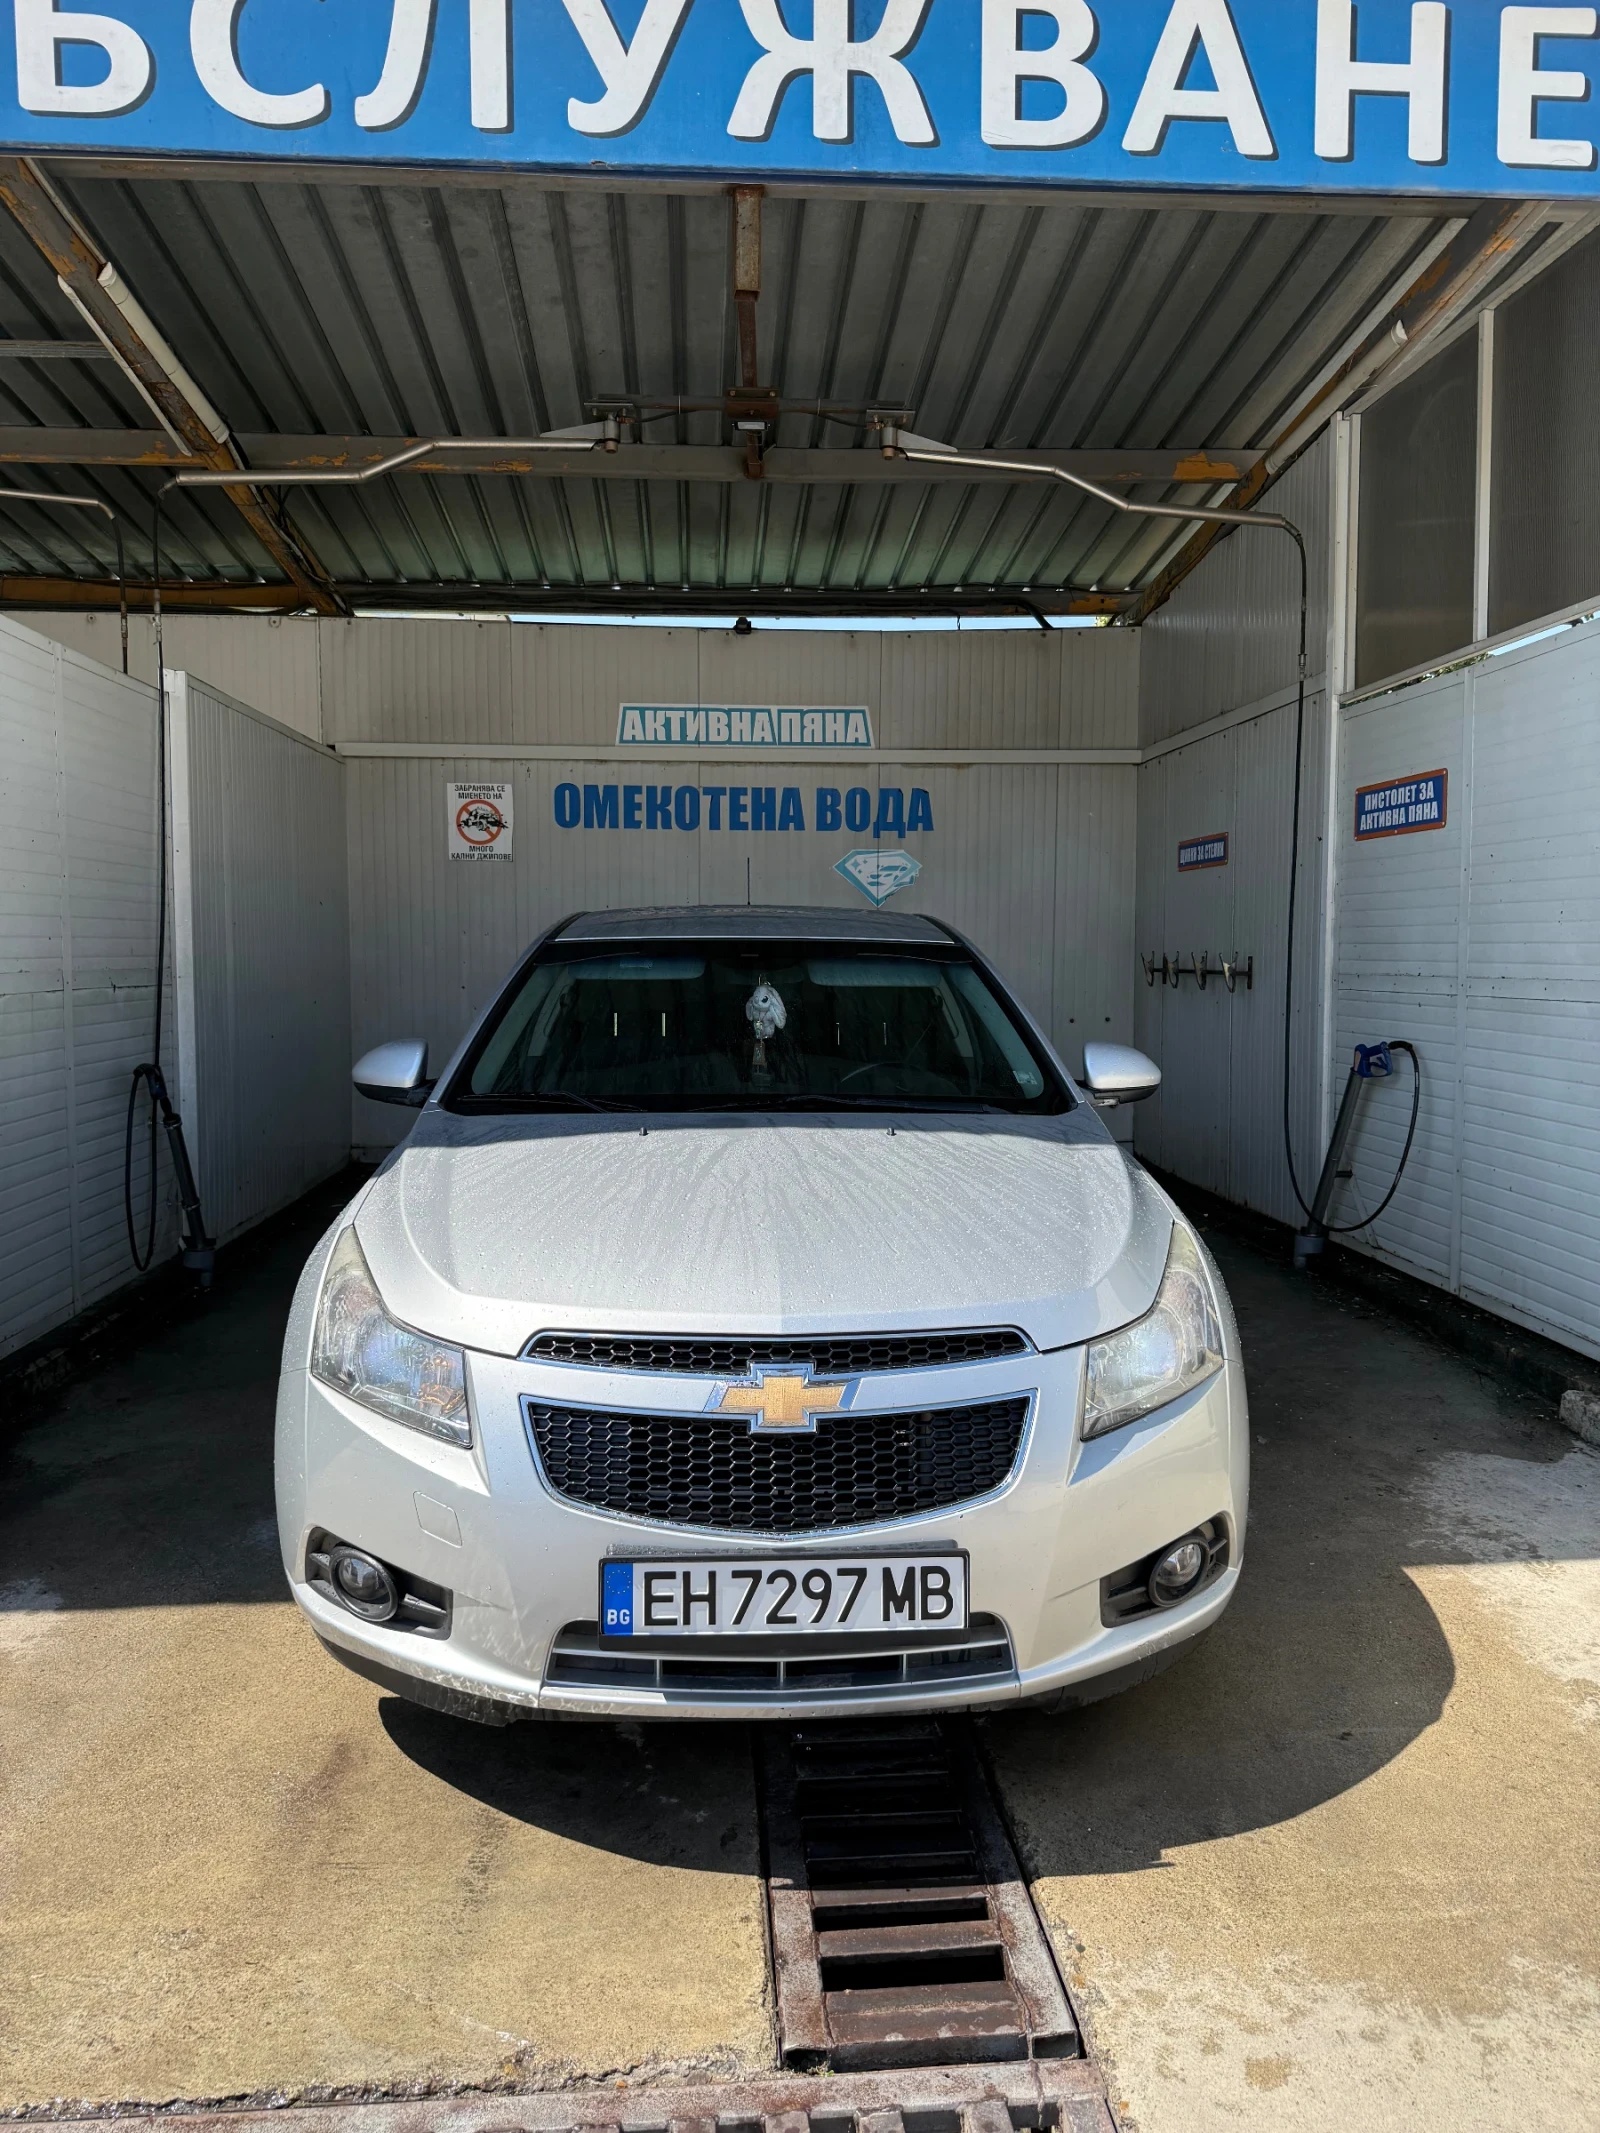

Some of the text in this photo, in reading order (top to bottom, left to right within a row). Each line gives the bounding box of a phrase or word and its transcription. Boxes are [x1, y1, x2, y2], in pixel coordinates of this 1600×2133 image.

[622, 709, 868, 744] АКТИВНА ПЯНА
[454, 784, 495, 792] ЗАБРАНЯВА
[458, 792, 491, 800] МИЕНЕТО
[1365, 781, 1434, 811] ПИСТОЛЕТ ЗА
[554, 783, 934, 838] ОМЕКОТЕНА ВОДА
[1360, 801, 1438, 830] АКТИВНА ПЯНА
[643, 1566, 953, 1626] EH 7297 MB
[607, 1609, 631, 1626] BG
